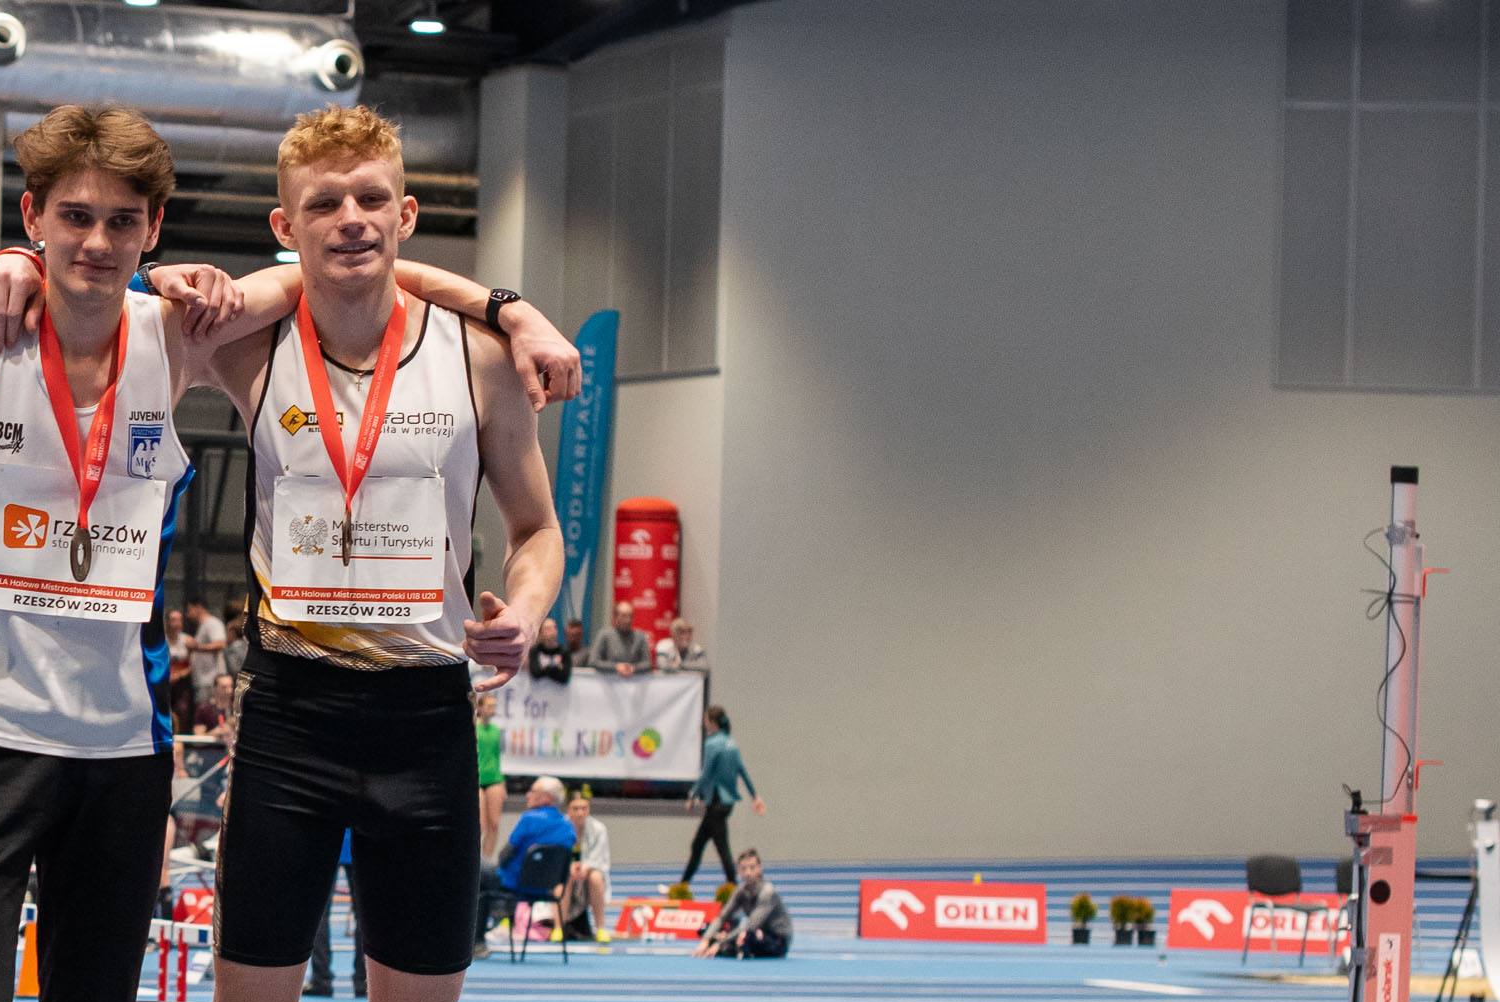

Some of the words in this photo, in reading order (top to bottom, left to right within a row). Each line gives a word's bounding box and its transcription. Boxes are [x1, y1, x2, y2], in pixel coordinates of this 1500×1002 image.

[380, 425, 397, 434] iła
[402, 426, 409, 434] w
[414, 425, 454, 438] precyzji
[53, 520, 148, 544] rzszów
[332, 520, 409, 532] Mnisterstwo
[92, 542, 145, 560] innowacji
[332, 535, 371, 548] Srtu
[374, 535, 378, 546] i
[380, 535, 434, 549] Turystyki
[10, 578, 39, 589] Halowe
[41, 582, 89, 595] Mistrzostwa
[90, 588, 113, 598] Polski
[115, 590, 129, 599] U18
[130, 591, 146, 600] U20
[301, 590, 332, 598] Halowe
[333, 590, 380, 599] Mistrzostwa
[382, 591, 406, 600] Polski
[407, 591, 420, 600] U18
[422, 592, 437, 600] U20
[13, 594, 81, 610] RZESZÓW
[84, 602, 117, 613] 2023
[307, 603, 376, 617] RZESZÓW
[377, 606, 411, 617] 2023
[576, 728, 626, 758] KIDS
[943, 902, 1029, 922] ORLEN
